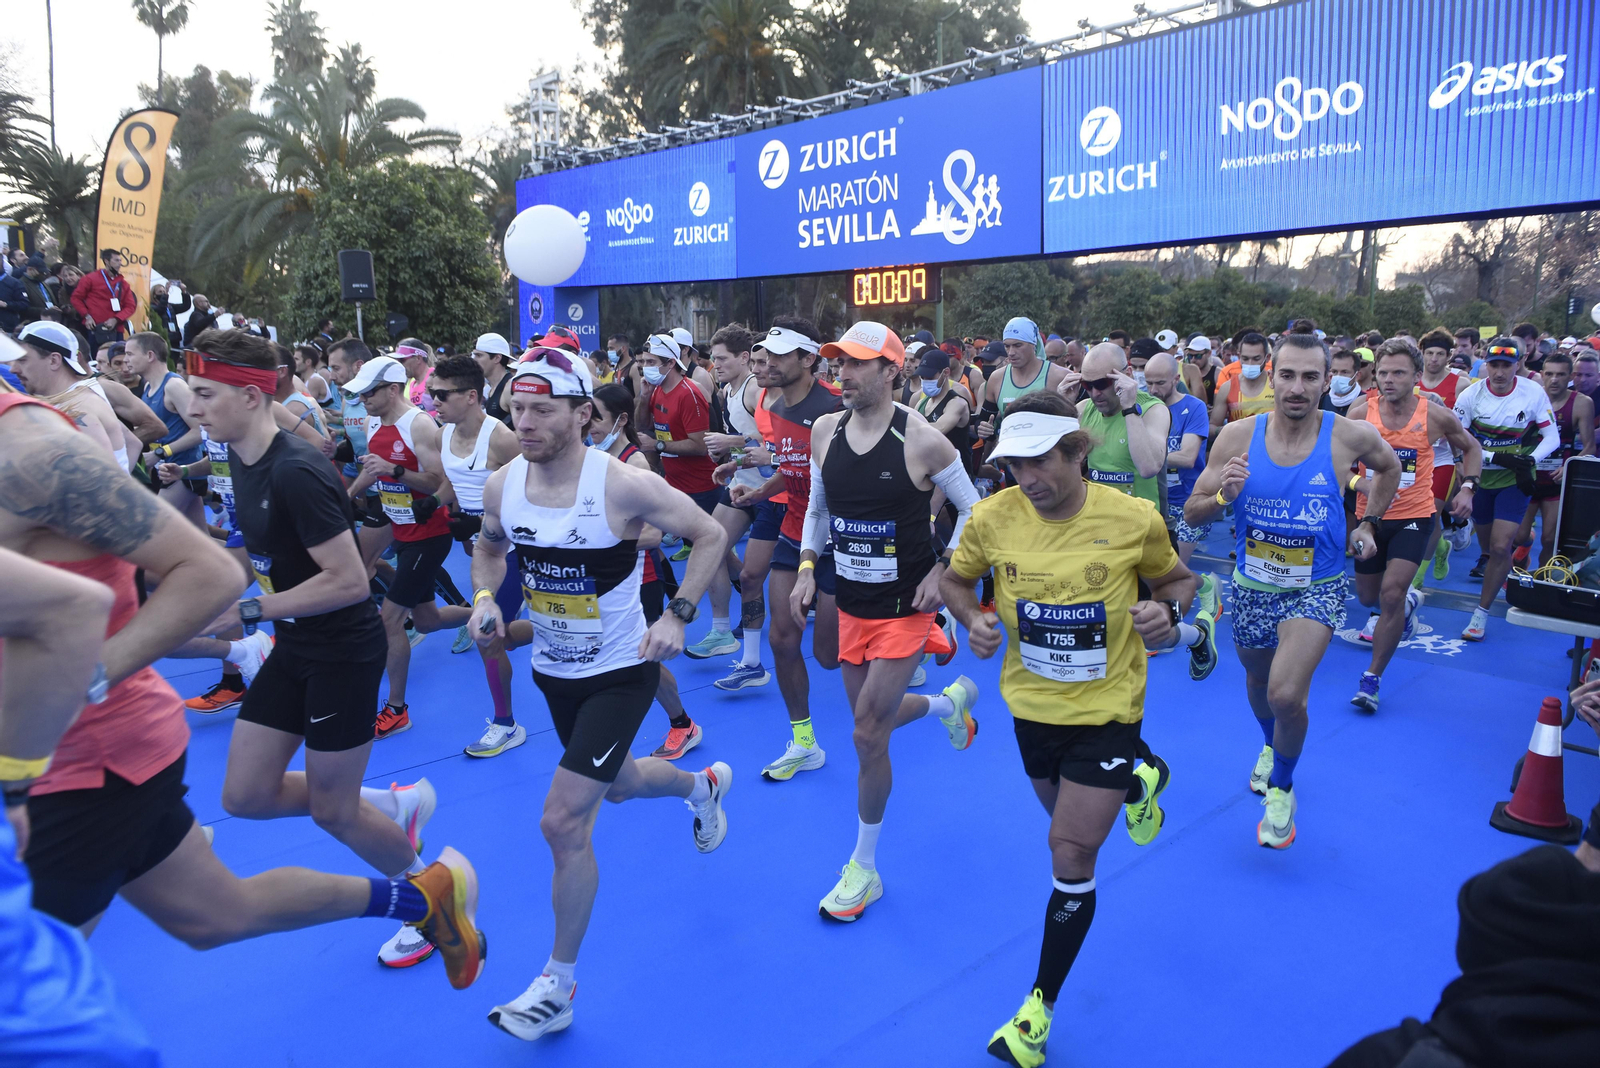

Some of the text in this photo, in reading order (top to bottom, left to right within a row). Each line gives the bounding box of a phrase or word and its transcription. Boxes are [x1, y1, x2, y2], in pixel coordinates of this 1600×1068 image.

[1472, 54, 1567, 96] asics
[799, 127, 898, 172] ZURICH
[1048, 161, 1158, 202] ZURICH
[799, 170, 899, 213] MARATÓN
[111, 196, 146, 217] IMD
[673, 223, 729, 246] ZURICH
[798, 208, 901, 249] SEVILLA
[568, 325, 596, 335] RICH
[781, 437, 793, 453] 22
[1100, 472, 1127, 481] ZURICH
[1244, 504, 1289, 520] SEVILLA
[847, 523, 887, 533] ZURICH
[1267, 534, 1306, 546] ZURICH
[848, 542, 872, 554] 2630
[850, 558, 871, 568] BUBU
[1270, 551, 1286, 563] 746
[1263, 562, 1291, 575] ECHEVE
[538, 581, 585, 592] ZURICH
[546, 602, 566, 614] 785
[1043, 608, 1095, 620] ZURICH
[551, 620, 567, 630] FLO
[1044, 632, 1076, 646] 1755
[1049, 652, 1072, 663] KIKE
